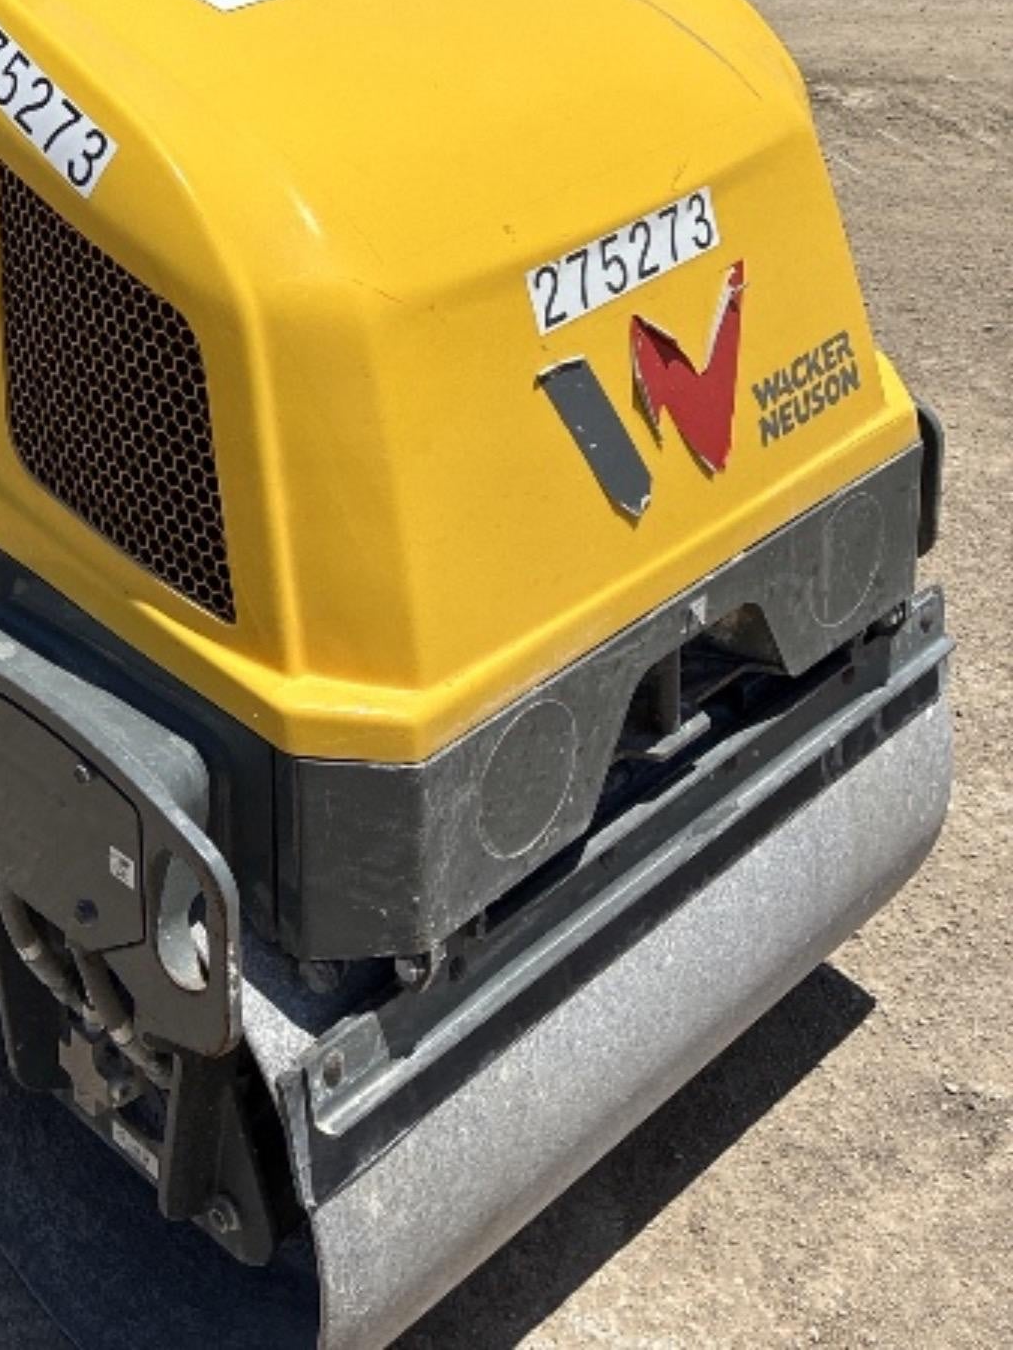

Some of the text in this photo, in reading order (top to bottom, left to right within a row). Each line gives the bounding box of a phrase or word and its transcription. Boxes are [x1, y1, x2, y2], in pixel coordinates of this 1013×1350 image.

[534, 193, 713, 328] 275273
[752, 330, 855, 411] WACKER
[758, 361, 861, 447] NEUSON
